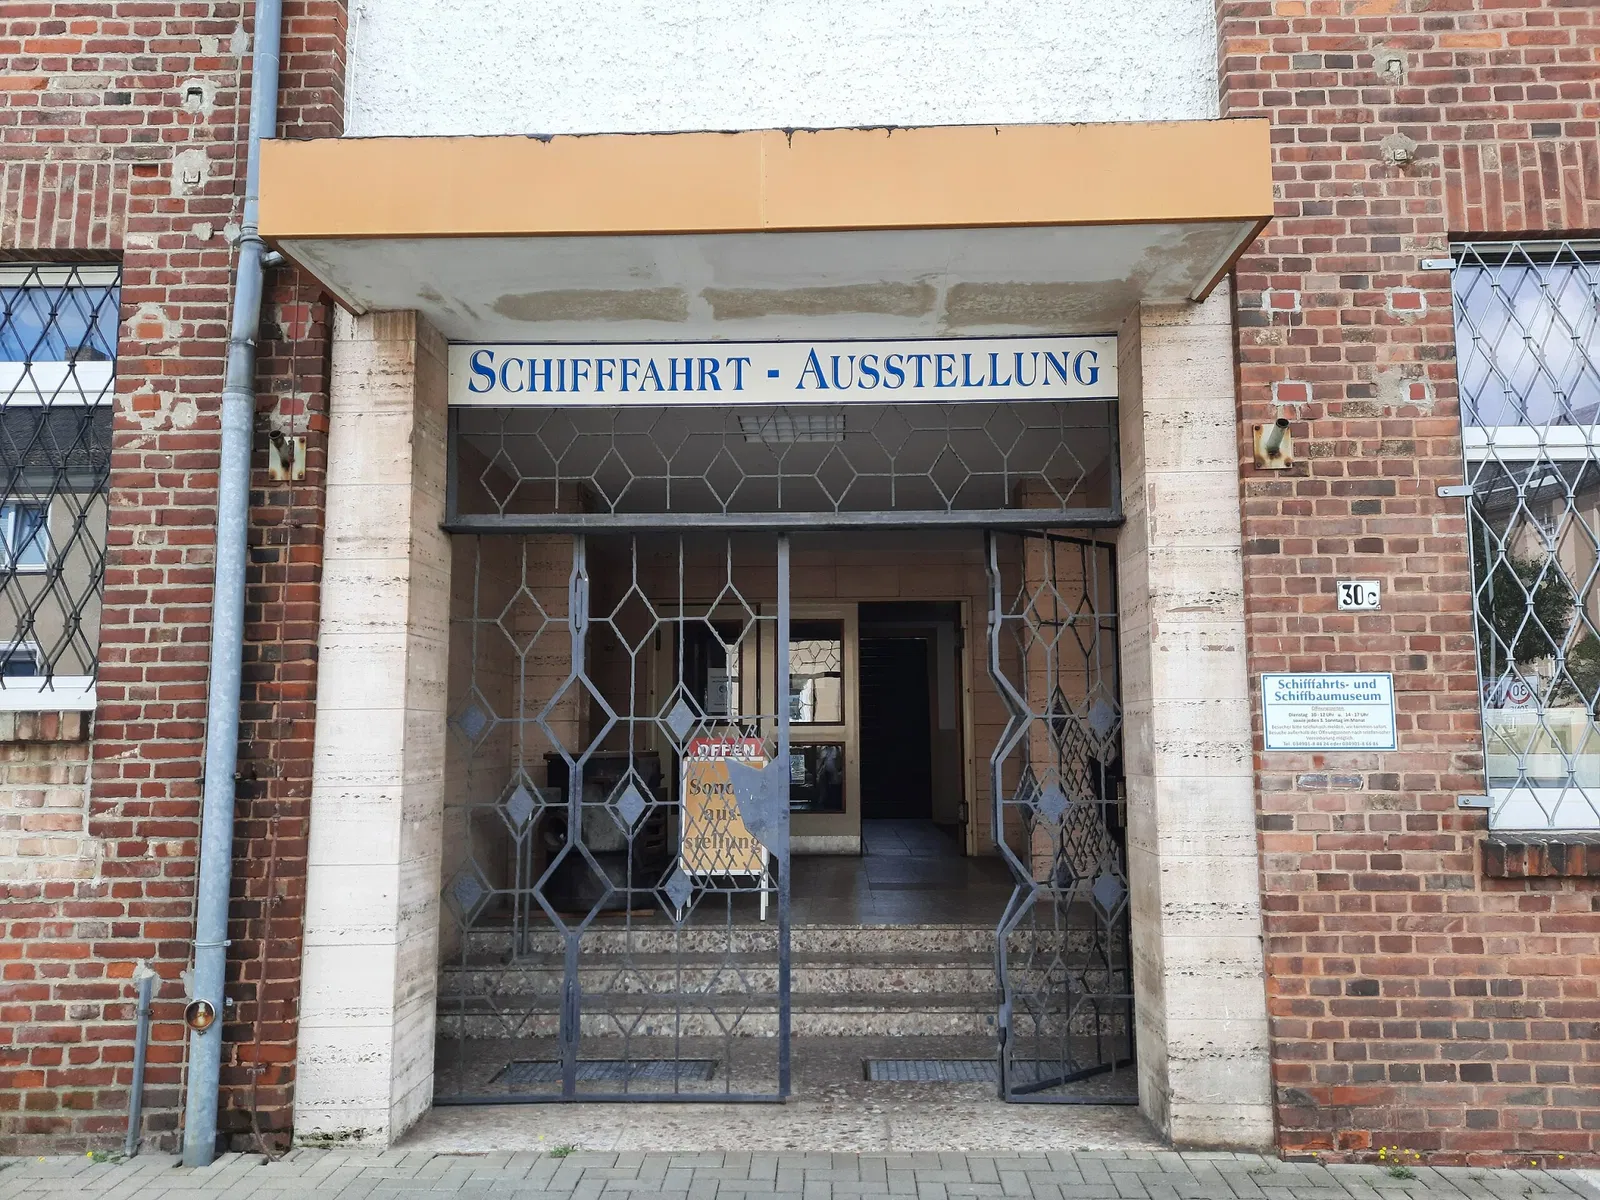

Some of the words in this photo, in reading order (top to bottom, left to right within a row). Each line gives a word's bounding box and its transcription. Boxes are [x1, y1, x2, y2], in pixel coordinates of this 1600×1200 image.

[468, 349, 751, 393] SCHIFFFAHRT
[795, 347, 1100, 389] AUSSTELLUNG
[1342, 584, 1364, 606] 30
[1278, 679, 1349, 689] Schifffahrts-
[1353, 679, 1377, 689] und
[1274, 691, 1382, 701] Schiffbaumuseum
[698, 744, 755, 756] OFFEN
